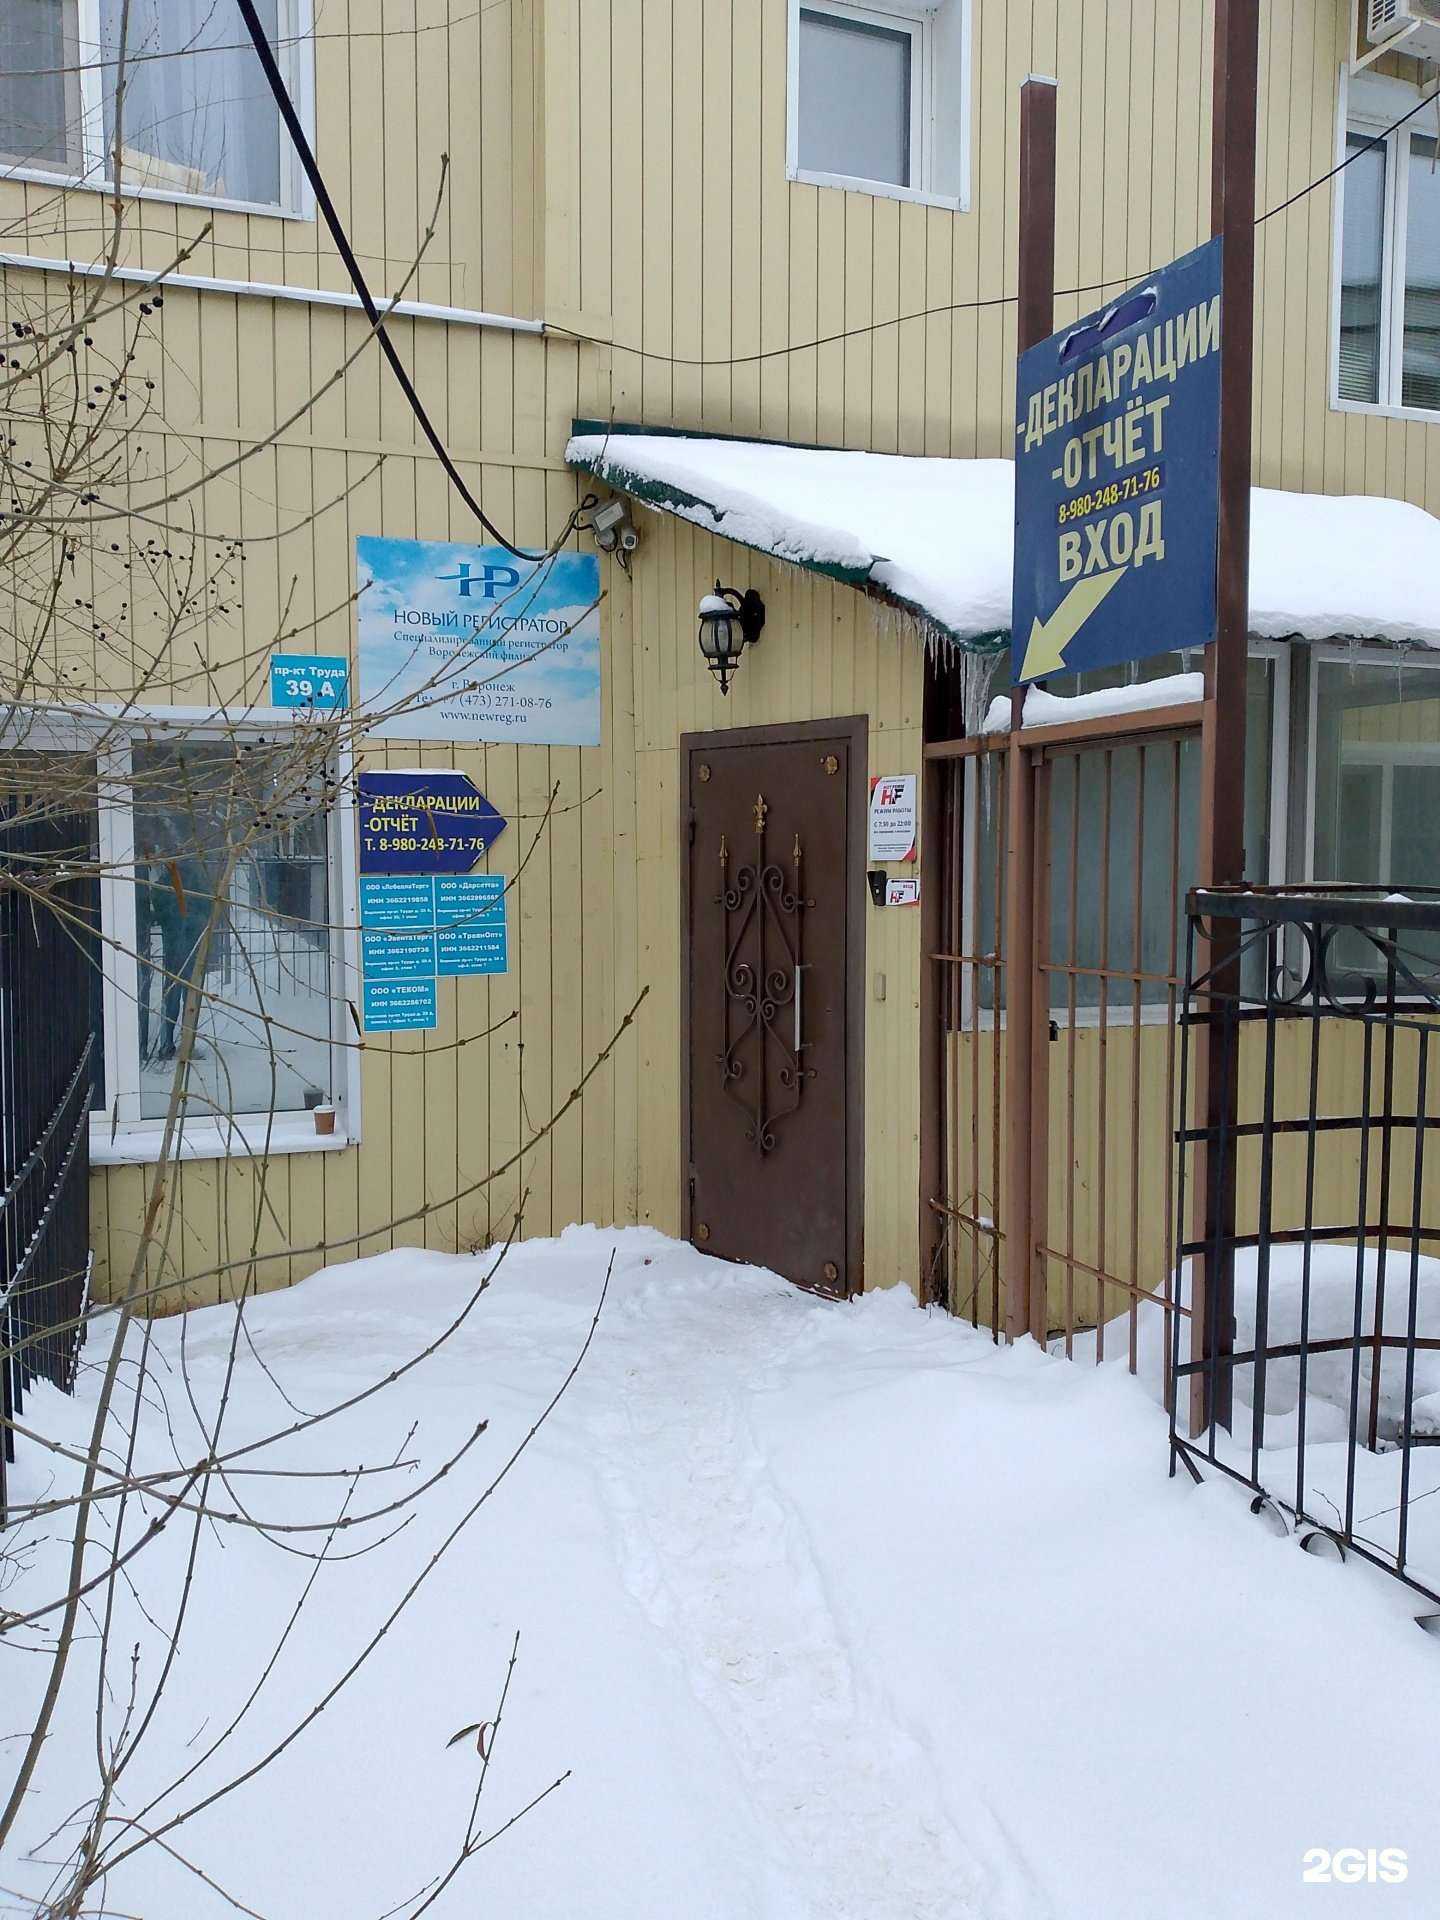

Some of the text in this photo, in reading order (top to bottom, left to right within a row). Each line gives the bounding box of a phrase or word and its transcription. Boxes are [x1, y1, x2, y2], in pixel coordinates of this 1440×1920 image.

[1016, 294, 1221, 454] -ДЕКЛАРАЦИИ
[1052, 394, 1171, 490] -ОТЧЁТ
[1058, 465, 1161, 525] 8-980-248-71-76
[1058, 500, 1166, 583] ВХОД
[394, 609, 568, 634] НОВЫЙ РЕГИСТРАТОР
[274, 666, 346, 679] пр-кт Труда
[285, 679, 335, 697] 39 А
[463, 678, 516, 694] Вронеж
[459, 693, 492, 709] (473)
[495, 696, 552, 709] 271-08-76
[440, 711, 528, 726] www.newreg.ru
[364, 838, 485, 851] Т. 8-980-248-71-76
[364, 935, 381, 943] ООО
[439, 932, 456, 940] ООО
[370, 987, 390, 995] ООО
